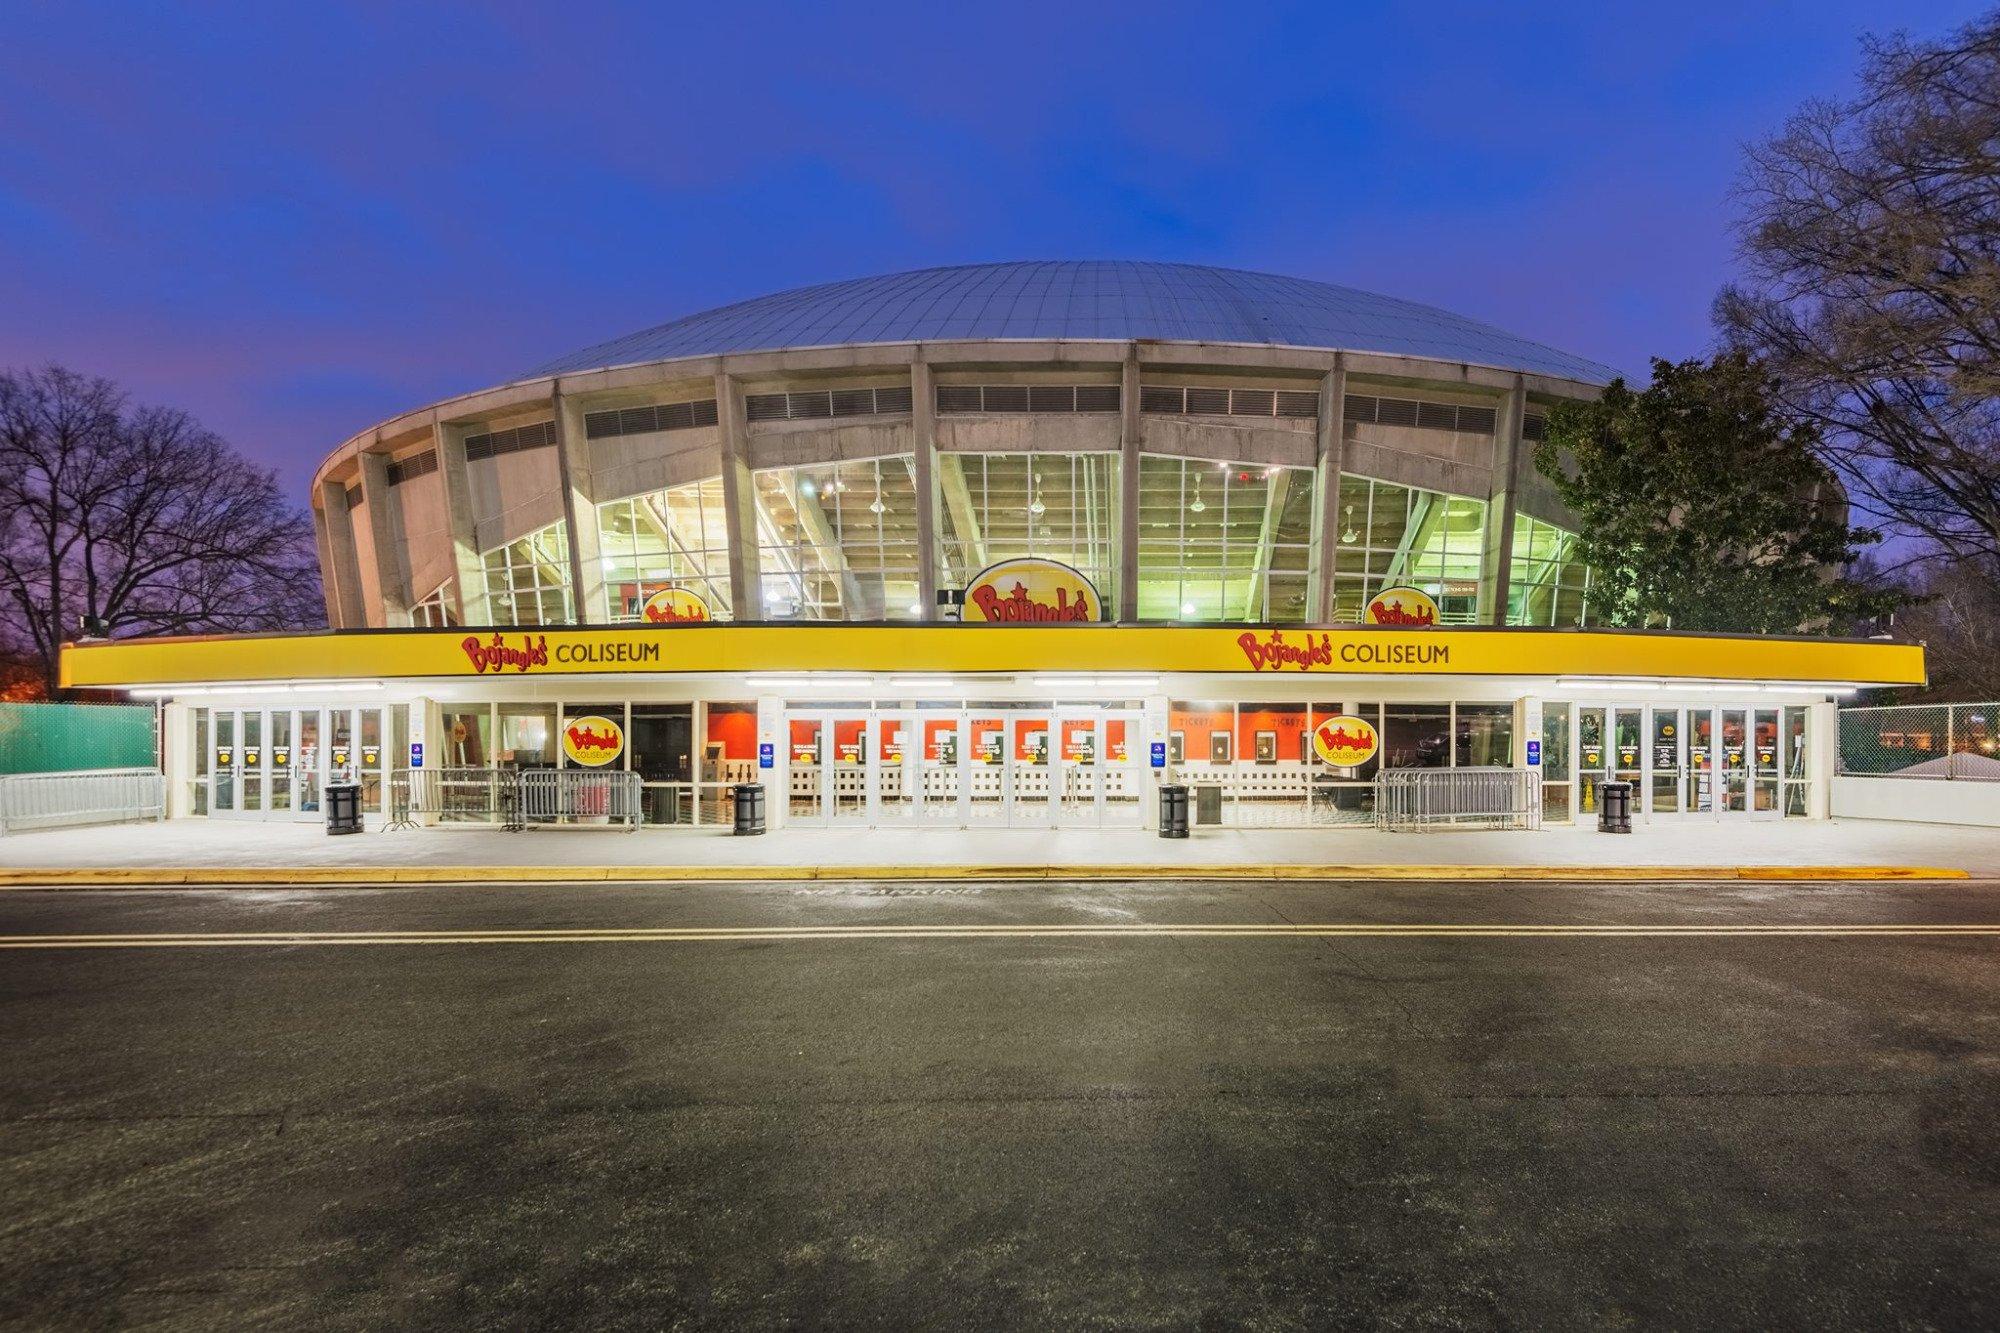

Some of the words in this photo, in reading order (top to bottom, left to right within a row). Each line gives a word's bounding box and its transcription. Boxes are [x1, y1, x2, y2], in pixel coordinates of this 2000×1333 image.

[462, 632, 548, 673] Bojangles'
[556, 643, 659, 663] COLISEUM
[1237, 628, 1332, 671] Bojangles'
[1341, 644, 1449, 663] COLISEUM
[1326, 752, 1365, 760] COLISEUM
